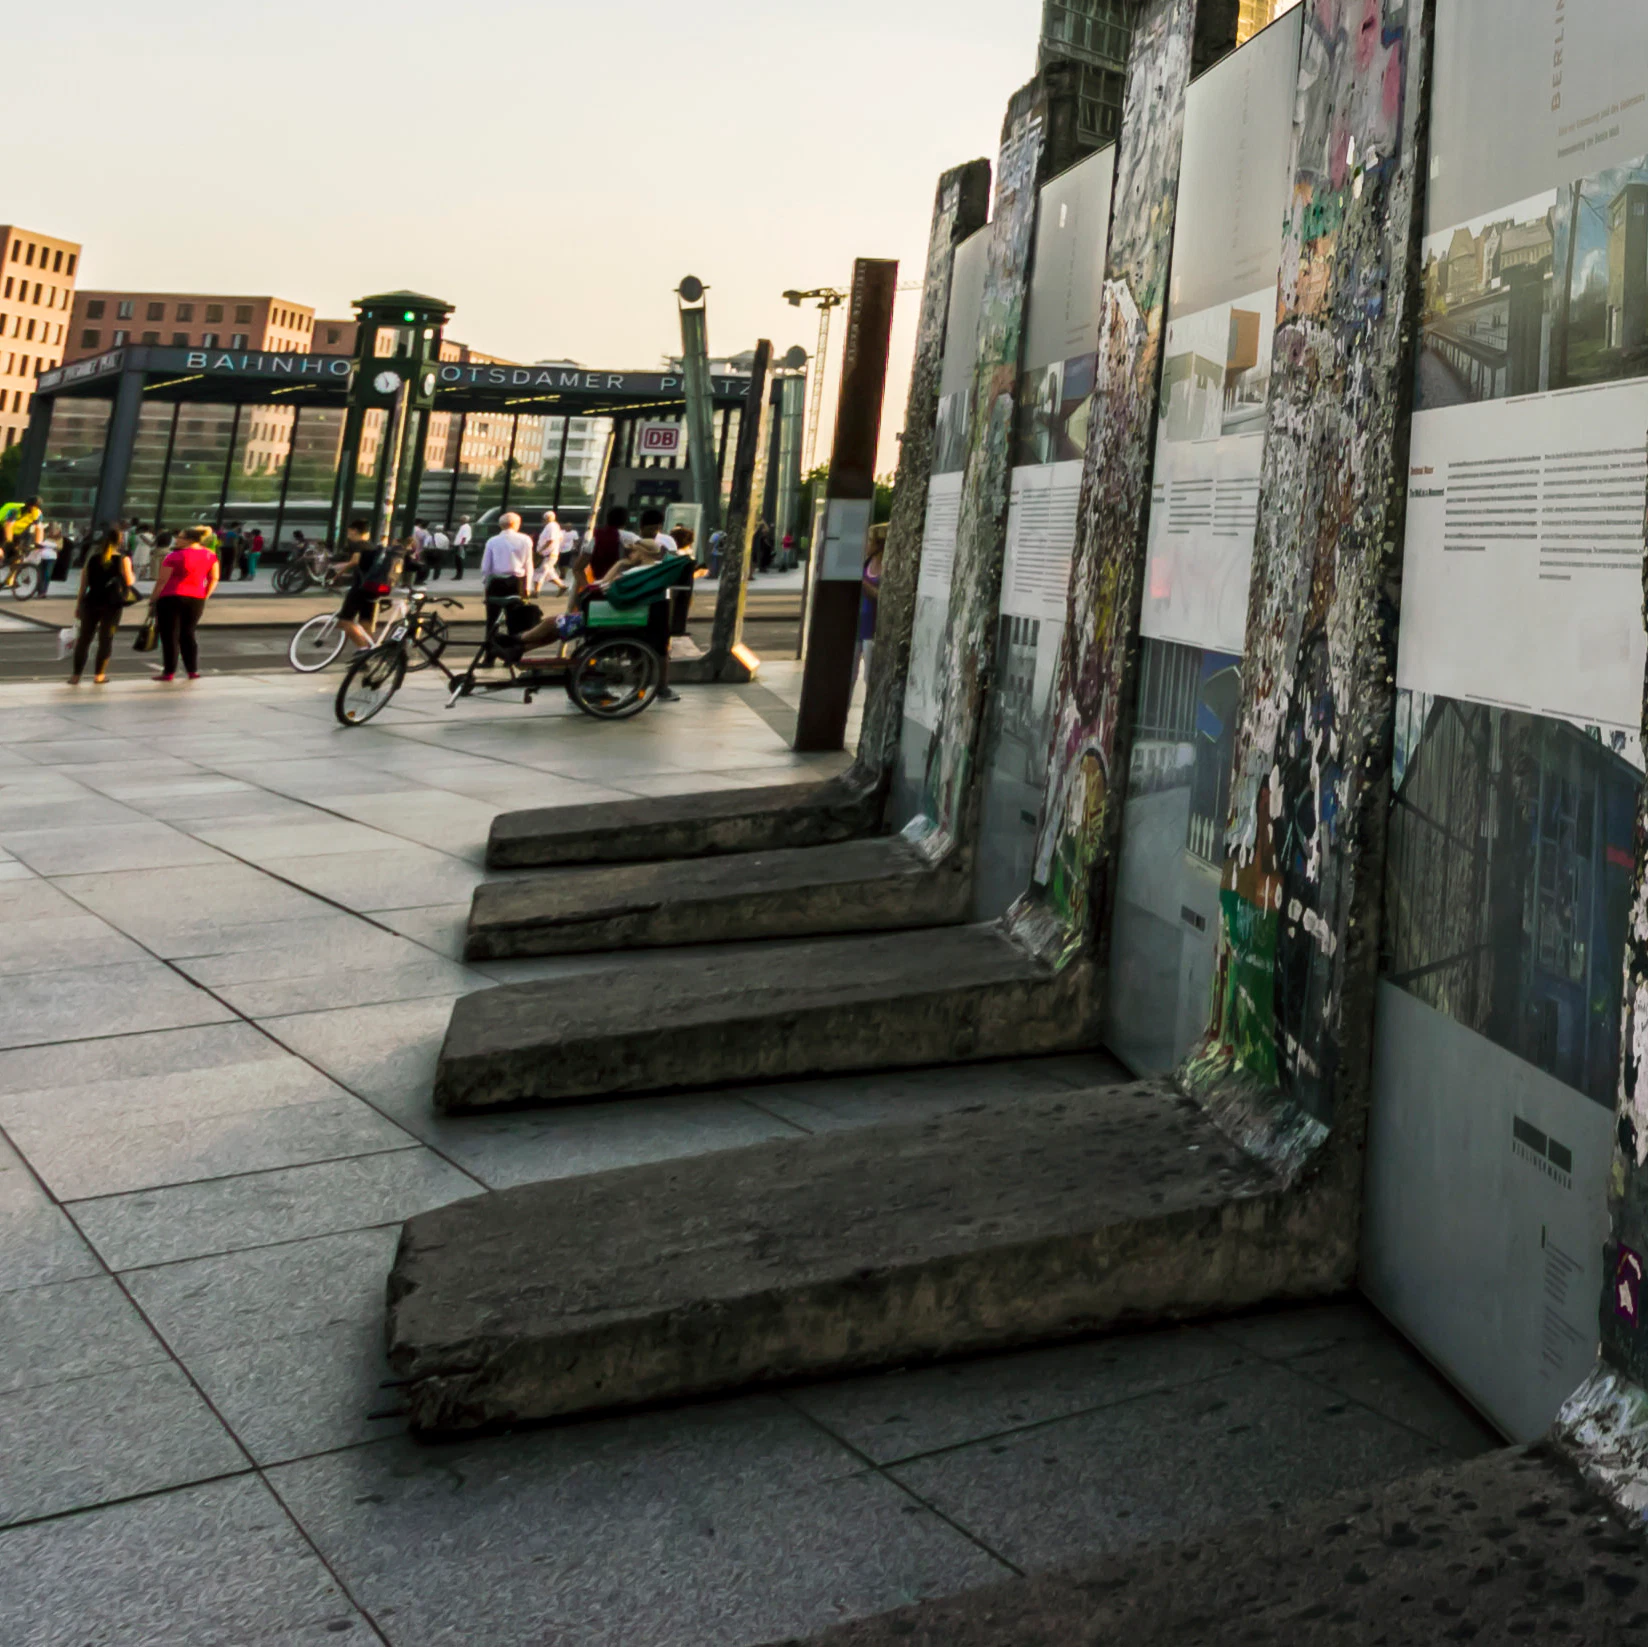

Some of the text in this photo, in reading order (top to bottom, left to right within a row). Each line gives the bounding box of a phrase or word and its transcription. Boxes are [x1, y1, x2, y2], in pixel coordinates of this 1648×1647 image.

[186, 352, 351, 376] BAHNHO
[441, 365, 625, 389] OTSDAMER
[649, 431, 674, 446] DB
